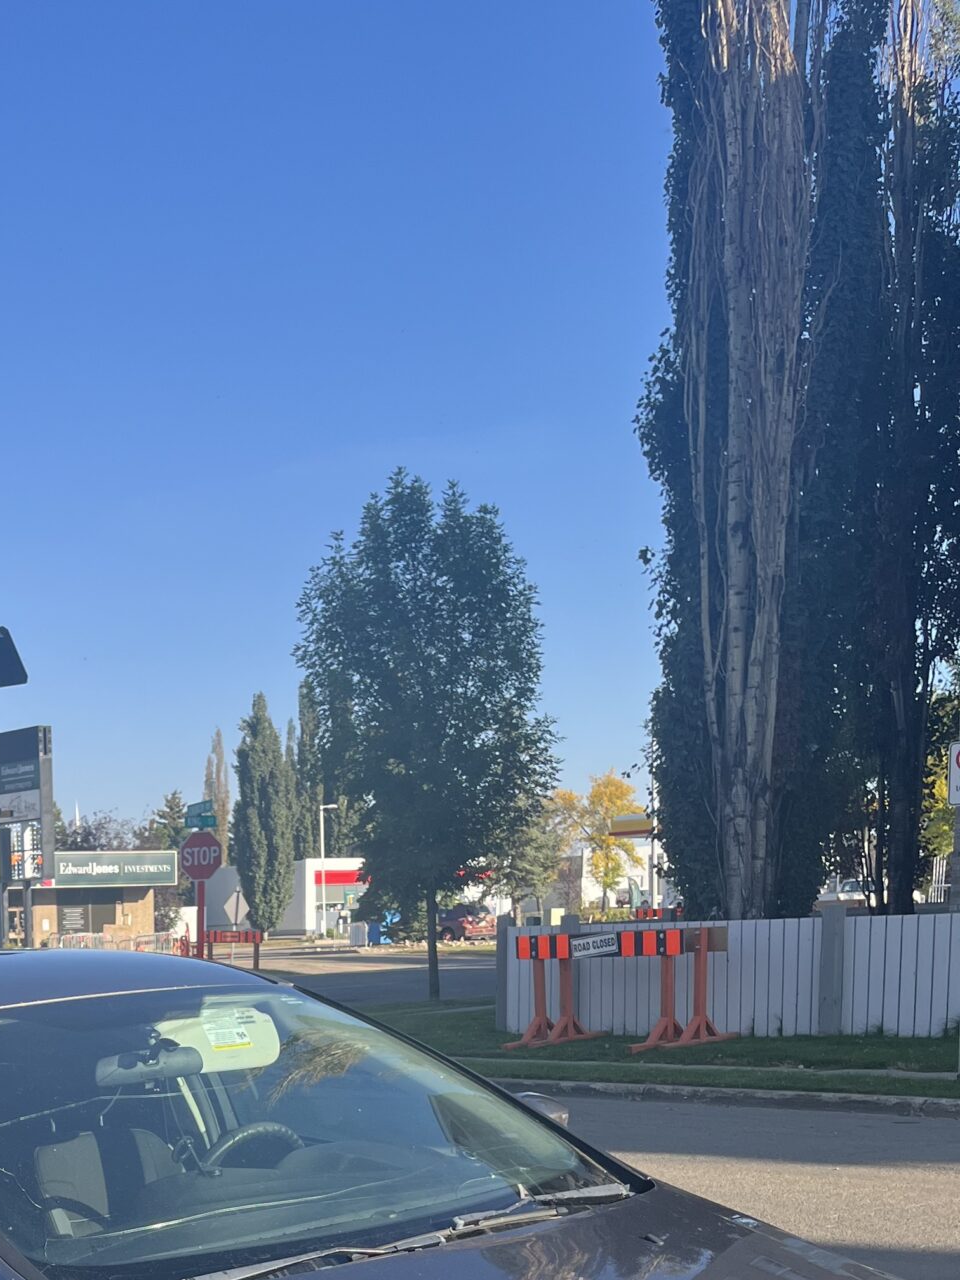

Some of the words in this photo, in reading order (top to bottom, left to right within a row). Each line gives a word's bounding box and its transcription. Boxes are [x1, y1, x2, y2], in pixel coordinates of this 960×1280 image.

[183, 846, 219, 866] STOP
[124, 864, 171, 873] INVESTMENTS
[573, 941, 590, 952] ROAD
[592, 937, 616, 950] CLOSED
